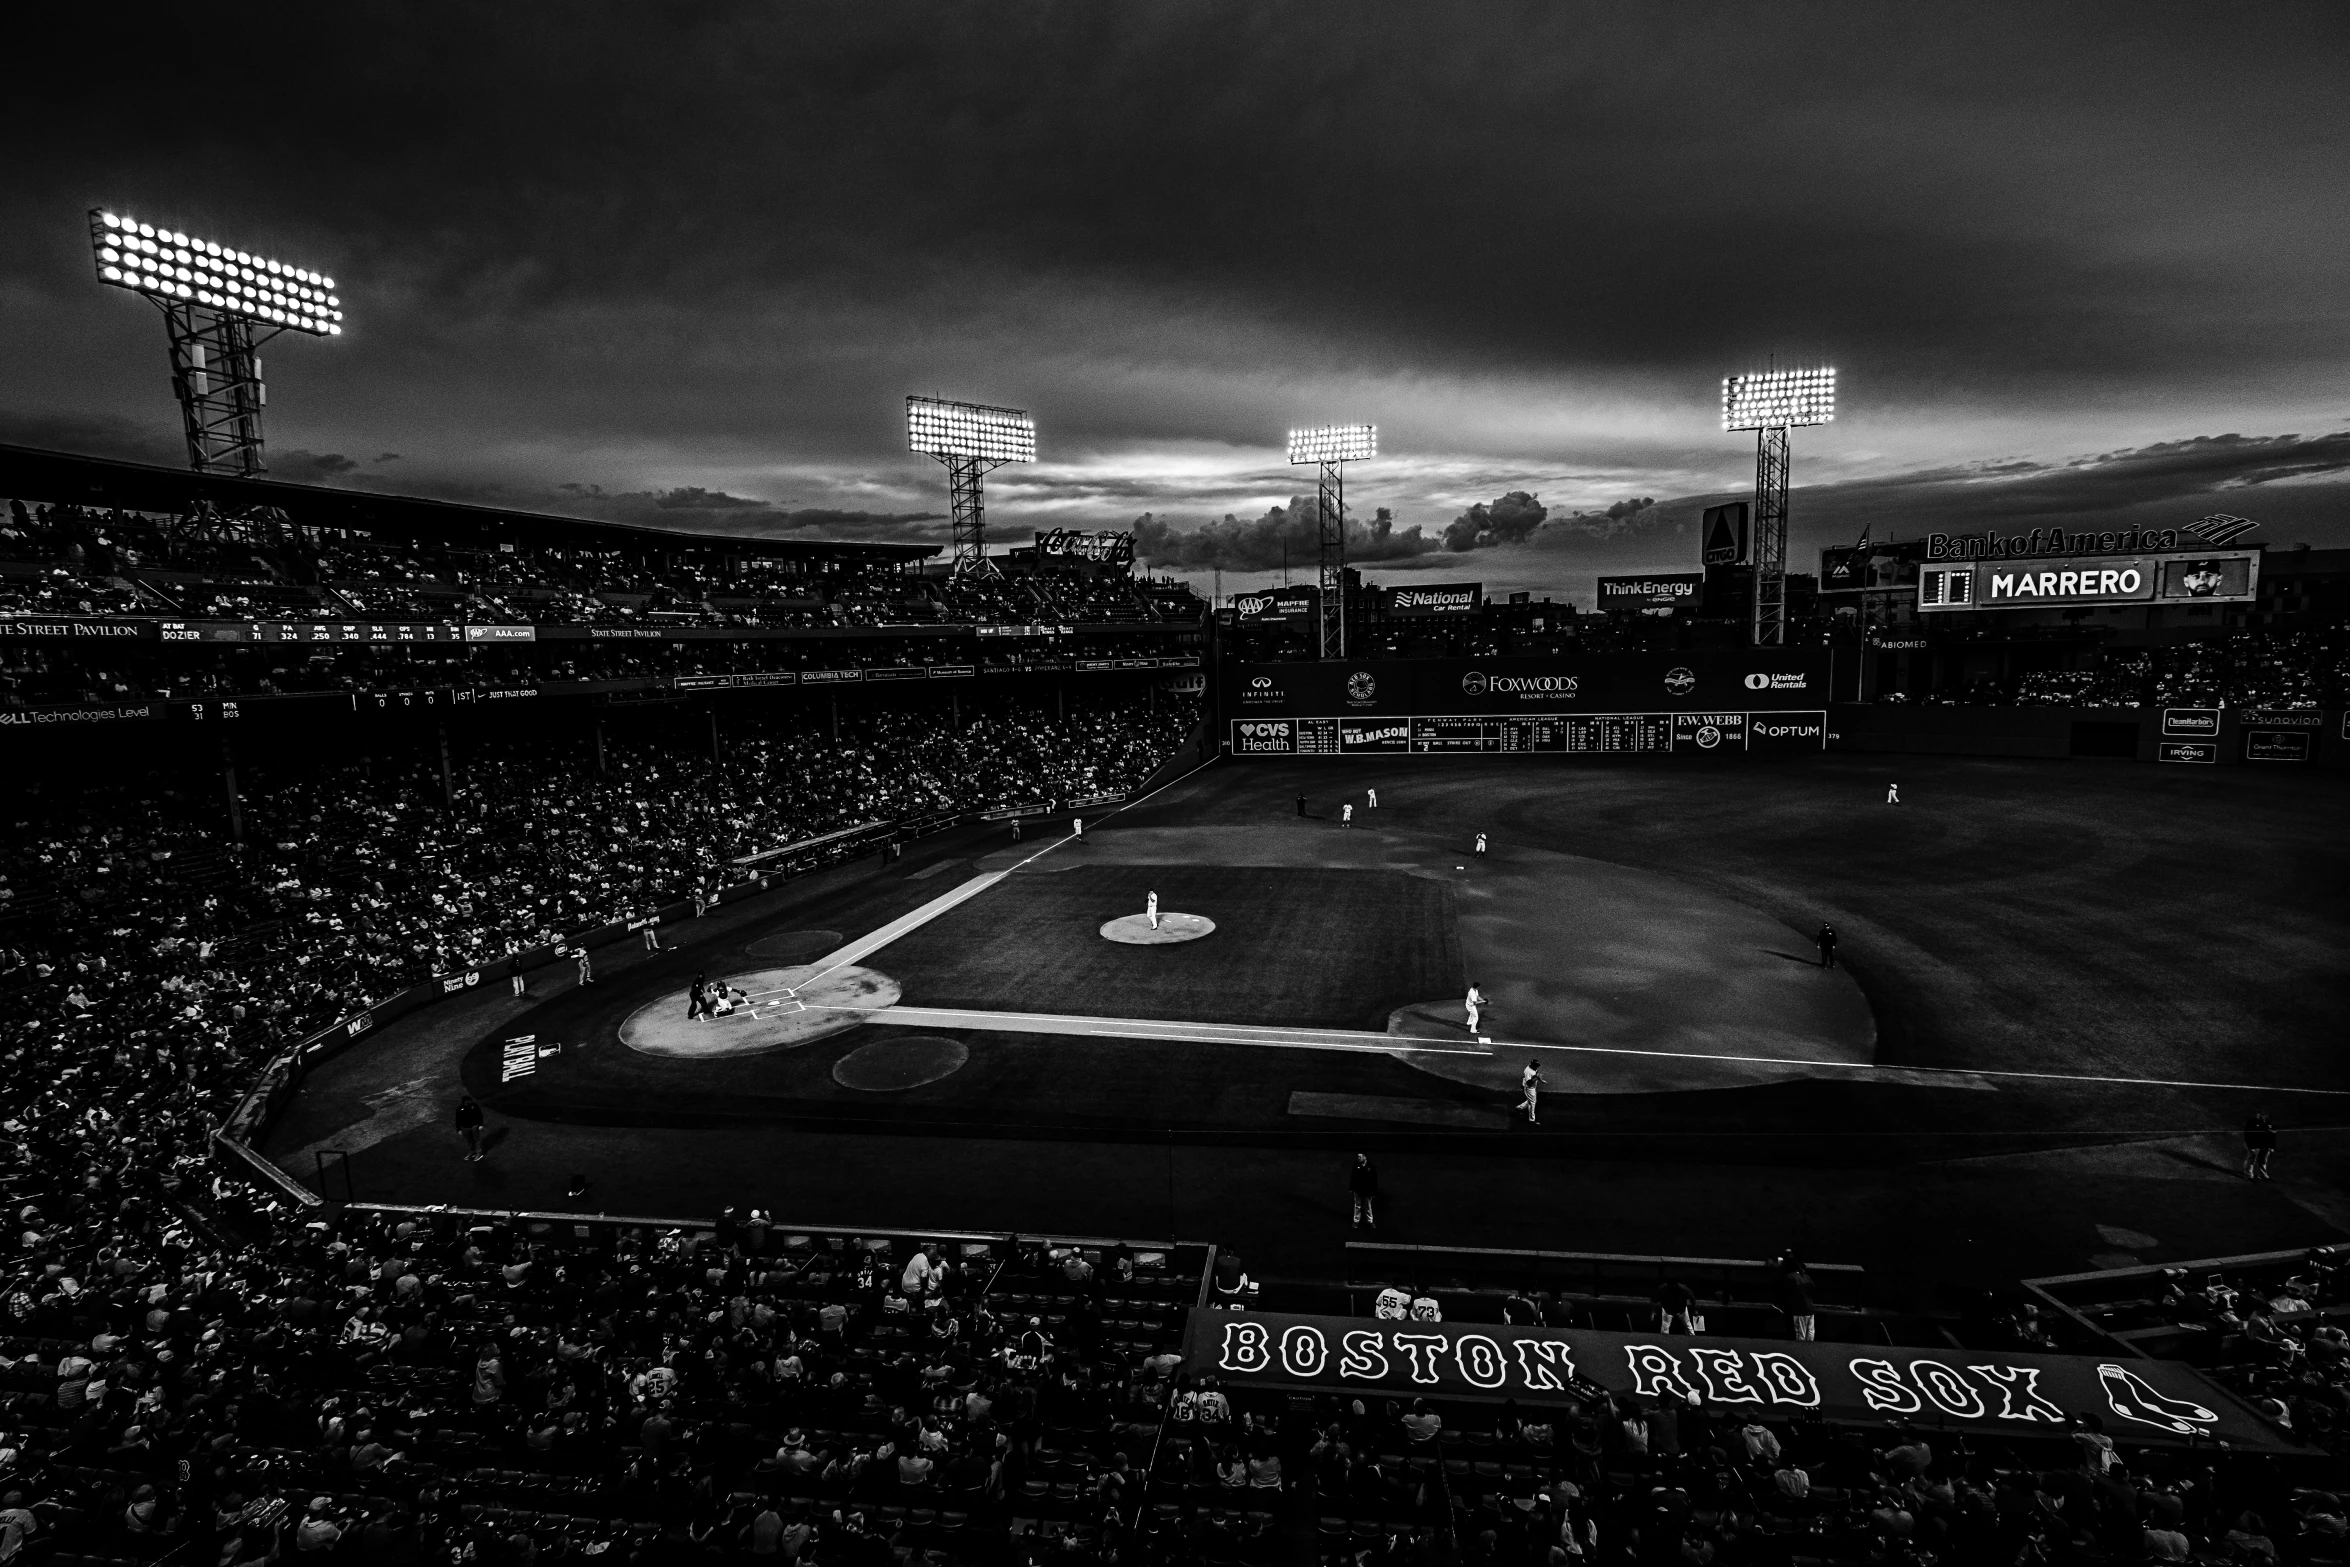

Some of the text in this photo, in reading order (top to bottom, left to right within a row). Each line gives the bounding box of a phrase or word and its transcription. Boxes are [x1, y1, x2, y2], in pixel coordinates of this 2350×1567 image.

[1927, 524, 2177, 559] Bank of America
[1707, 548, 1734, 562] CITGO
[1603, 581, 1693, 596] ThinkEnergy
[1991, 569, 2140, 599] MARRERO
[1276, 599, 1310, 607] MAPFRE
[1412, 590, 1474, 606] National
[1241, 599, 1260, 613] AAA
[16, 622, 69, 635] STREET
[73, 623, 138, 636] PAVILION
[495, 630, 530, 638] AAA.com
[591, 629, 662, 637] STATE STREET PAVILION
[162, 630, 200, 640] DOZIER
[280, 632, 298, 640] 324
[311, 632, 330, 640] .250
[341, 632, 359, 640] .340
[1880, 640, 1927, 649] ABIOMED
[803, 671, 859, 680] COLUMBIA TECH
[1771, 672, 1805, 681] United
[1489, 675, 1578, 692] FOXWOODS
[1770, 680, 1807, 689] Rentals
[488, 689, 538, 699] JUST THAT GOOD
[1519, 692, 1544, 700] RESORT
[379, 698, 385, 708] 0
[404, 697, 410, 706] 0
[428, 696, 434, 705] 0
[191, 704, 204, 712] 53
[222, 702, 237, 710] MIN
[29, 709, 116, 723] Technologies
[118, 705, 150, 718] Level
[194, 712, 204, 720] 31
[223, 710, 240, 718] BOS
[1677, 715, 1702, 726] F.W.
[1703, 714, 1742, 726] WEBB
[2258, 716, 2320, 724] sunovion
[1255, 723, 1290, 737] CVS
[1768, 725, 1820, 737] OPTUM
[1242, 738, 1291, 751] Health
[1423, 744, 1429, 752] 2
[2170, 749, 2205, 757] IRVING
[443, 976, 464, 986] Ninety
[444, 982, 464, 993] Nine
[857, 1275, 873, 1289] 34
[1418, 1306, 1434, 1317] 73
[1219, 1321, 2068, 1424] BOSTON RED SOX
[649, 1381, 664, 1393] 25
[1200, 1408, 1219, 1420] 34
[177, 1459, 191, 1482] B
